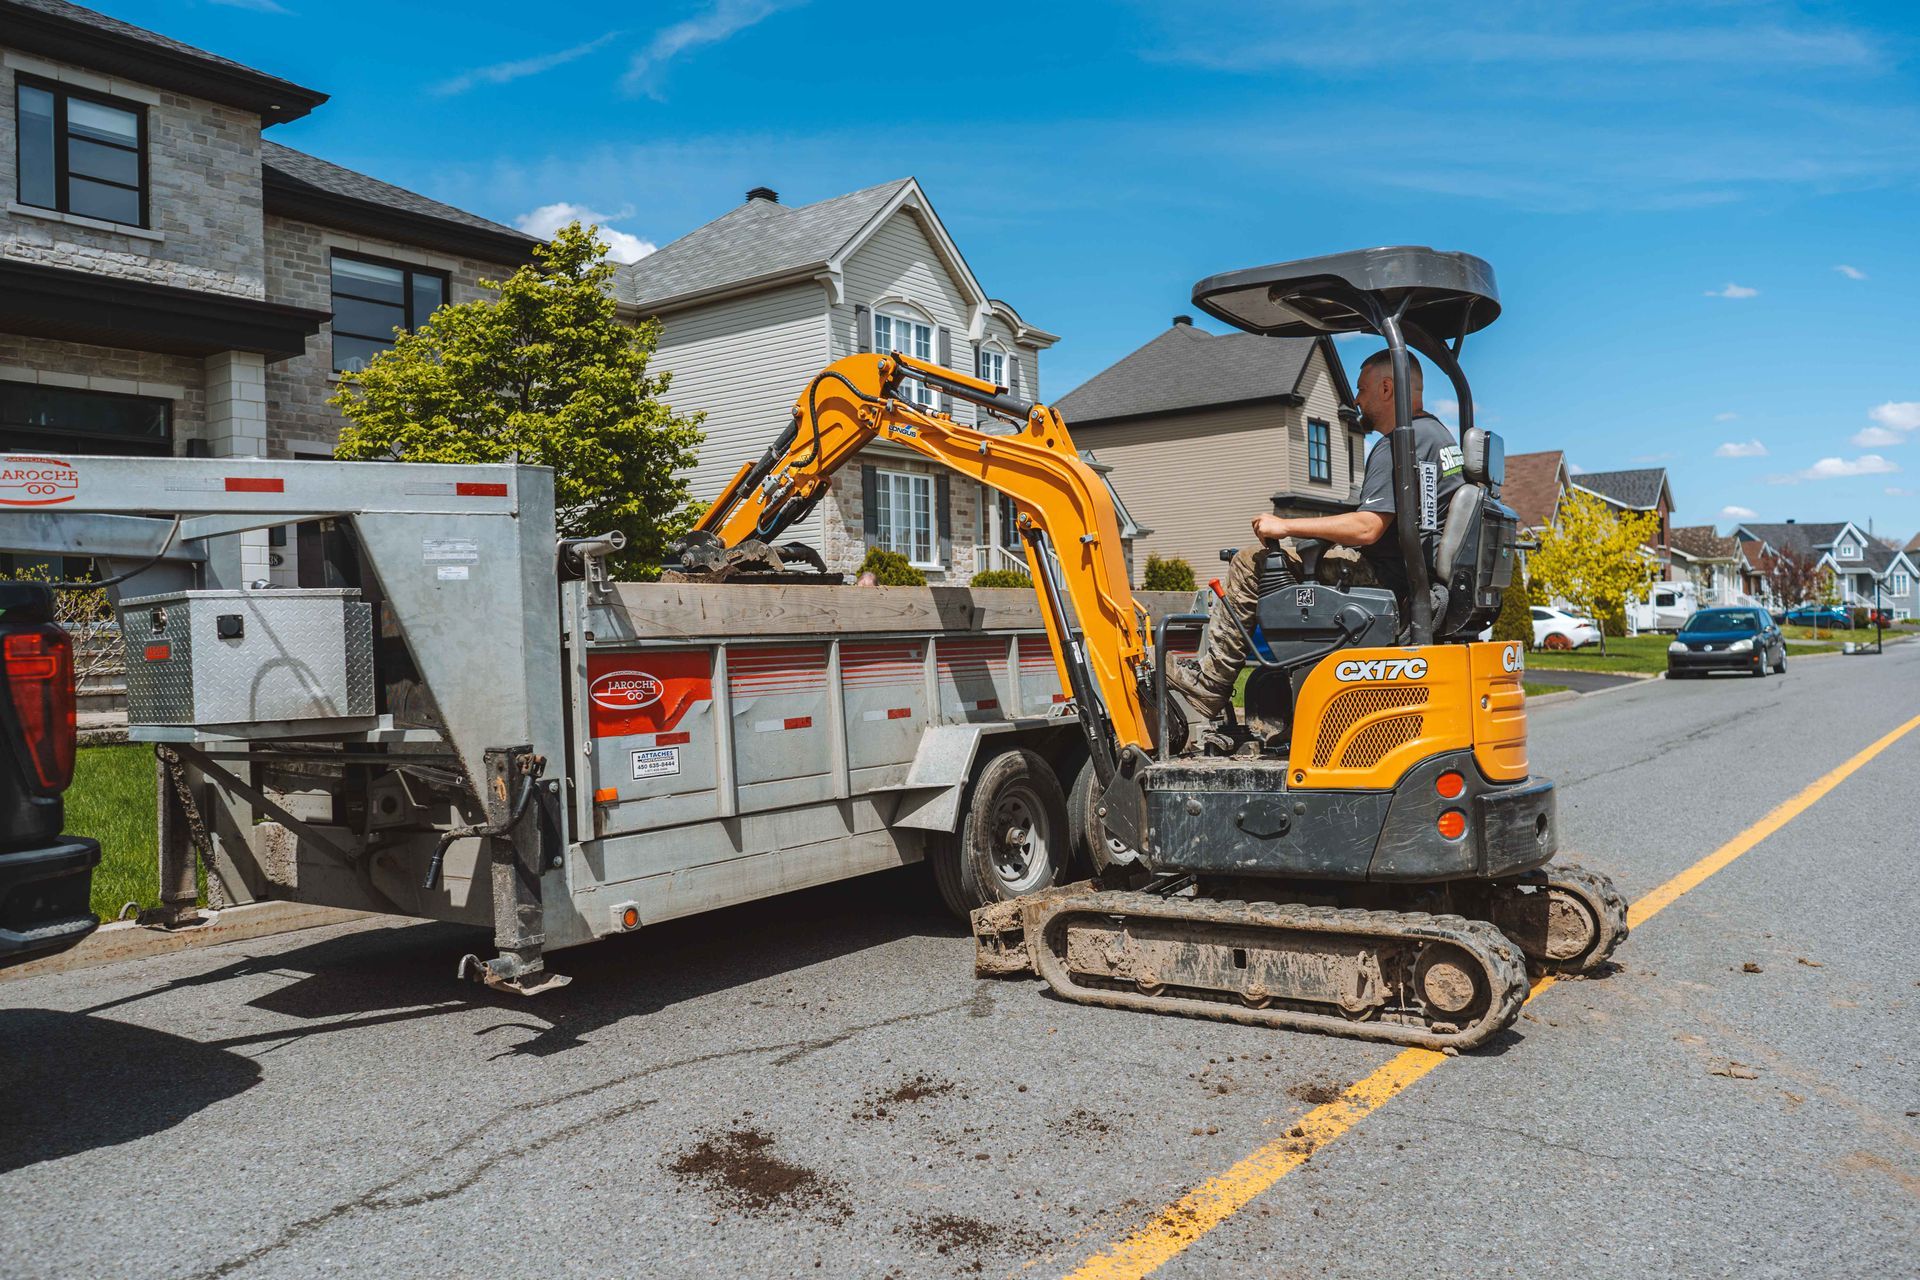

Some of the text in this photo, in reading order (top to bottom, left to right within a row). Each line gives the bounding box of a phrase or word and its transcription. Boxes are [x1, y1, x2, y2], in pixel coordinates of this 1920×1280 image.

[0, 470, 78, 480] AROCHE
[1335, 657, 1428, 682] CX17C
[608, 680, 656, 690] LAROCHE
[641, 750, 673, 760] ATTACHES
